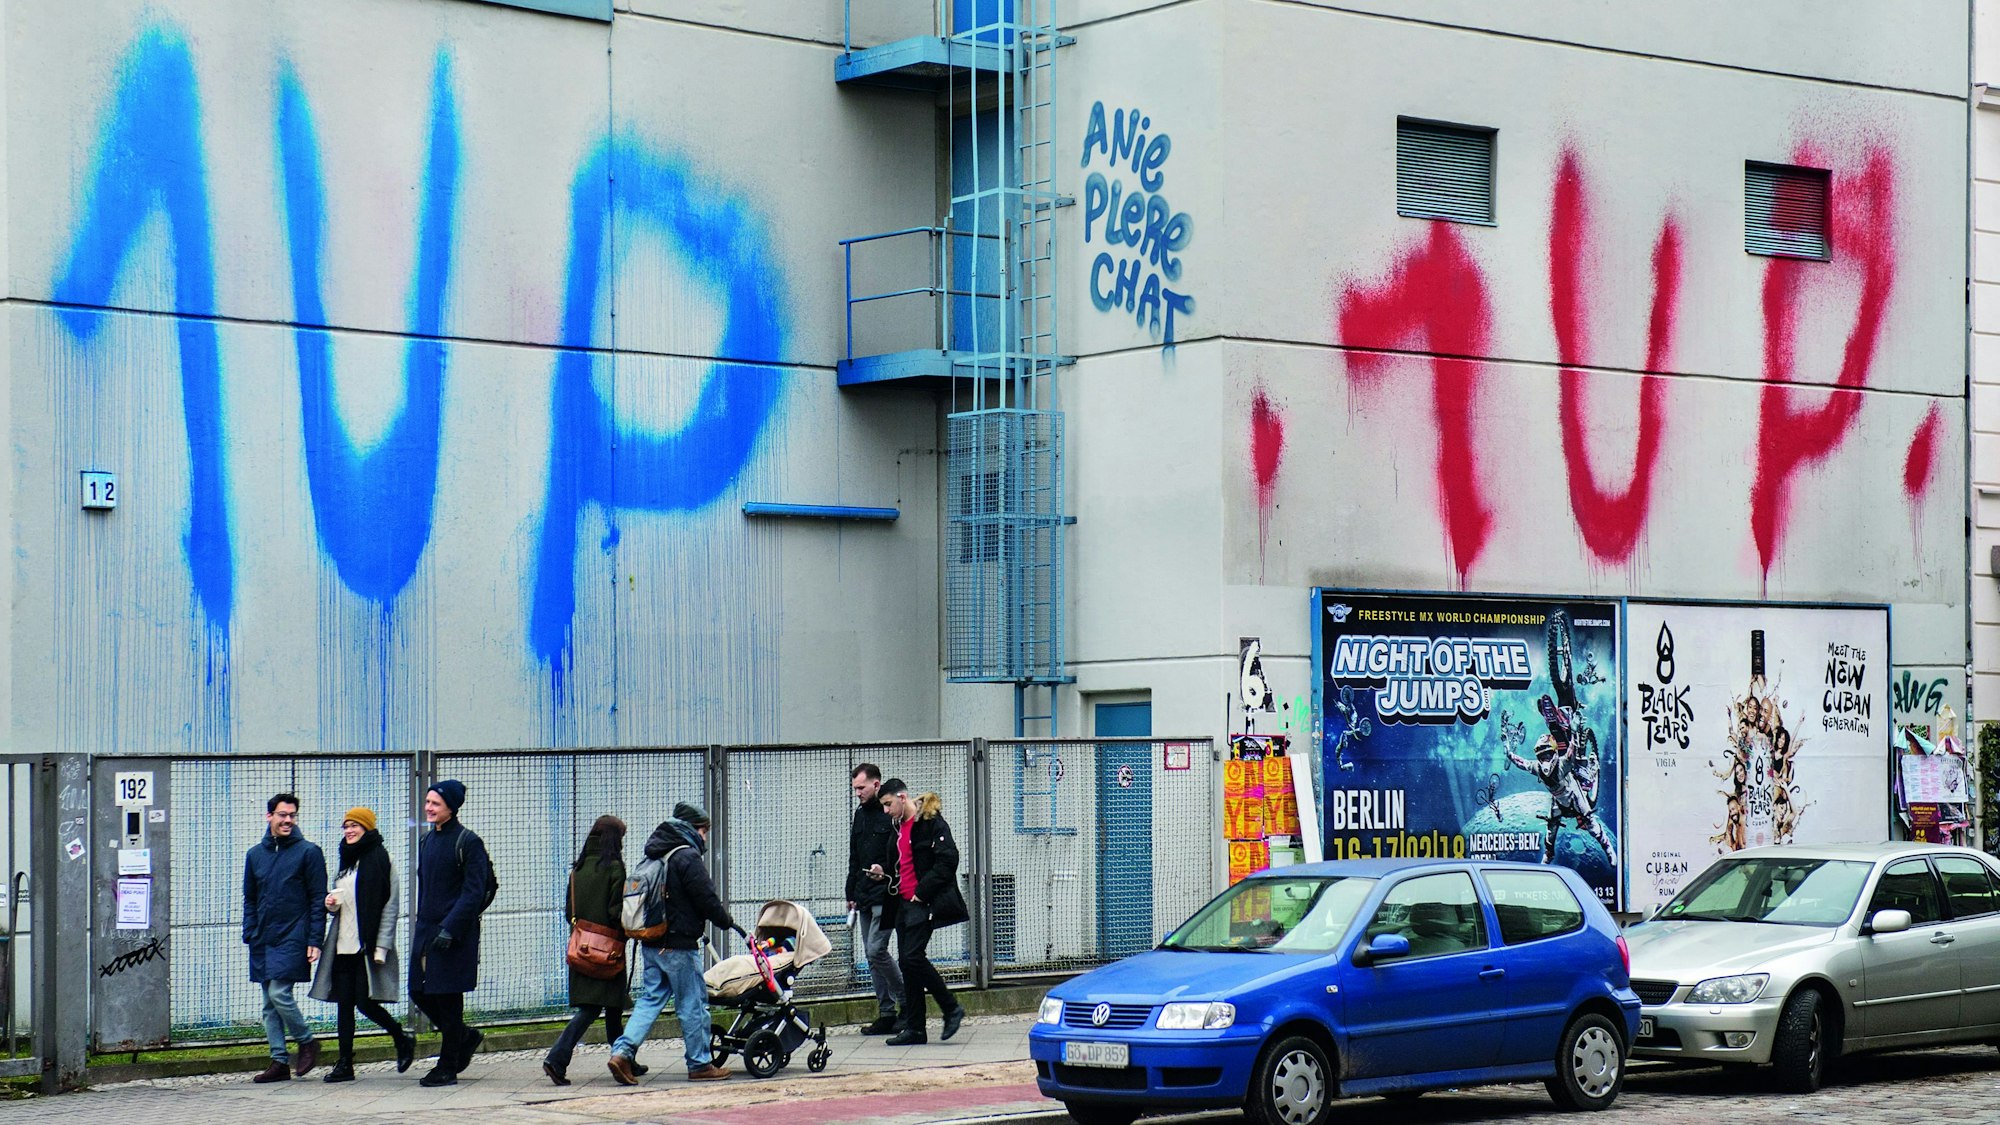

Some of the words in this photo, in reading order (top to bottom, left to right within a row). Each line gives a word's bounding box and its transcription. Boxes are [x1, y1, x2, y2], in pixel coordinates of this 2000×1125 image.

[1090, 252, 1195, 359] CHAT
[52, 24, 785, 672] 1UP
[1358, 609, 1416, 621] FREESTYLE
[1419, 611, 1434, 622] MX
[1437, 612, 1472, 623] WORLD
[1473, 613, 1546, 625] CHAMPIONSHIP
[1335, 641, 1428, 674] NIGHT
[1434, 642, 1469, 675] OF
[1472, 643, 1530, 675] THE
[1825, 657, 1866, 691] NEW
[1380, 680, 1480, 710] JUMPS
[1638, 682, 1694, 721] BLACK
[1823, 689, 1871, 719] CUBAN
[1642, 713, 1690, 751] TEARS
[1822, 715, 1869, 738] GENERATION
[120, 778, 147, 799] 192
[1333, 789, 1405, 830] BERLIN
[1470, 833, 1541, 851] MERCEDES-BENZ
[1646, 861, 1688, 873] CUBAN
[1595, 886, 1604, 897] 13
[1605, 886, 1614, 897] 13
[1659, 888, 1675, 896] RUM
[1105, 1046, 1126, 1063] 859
